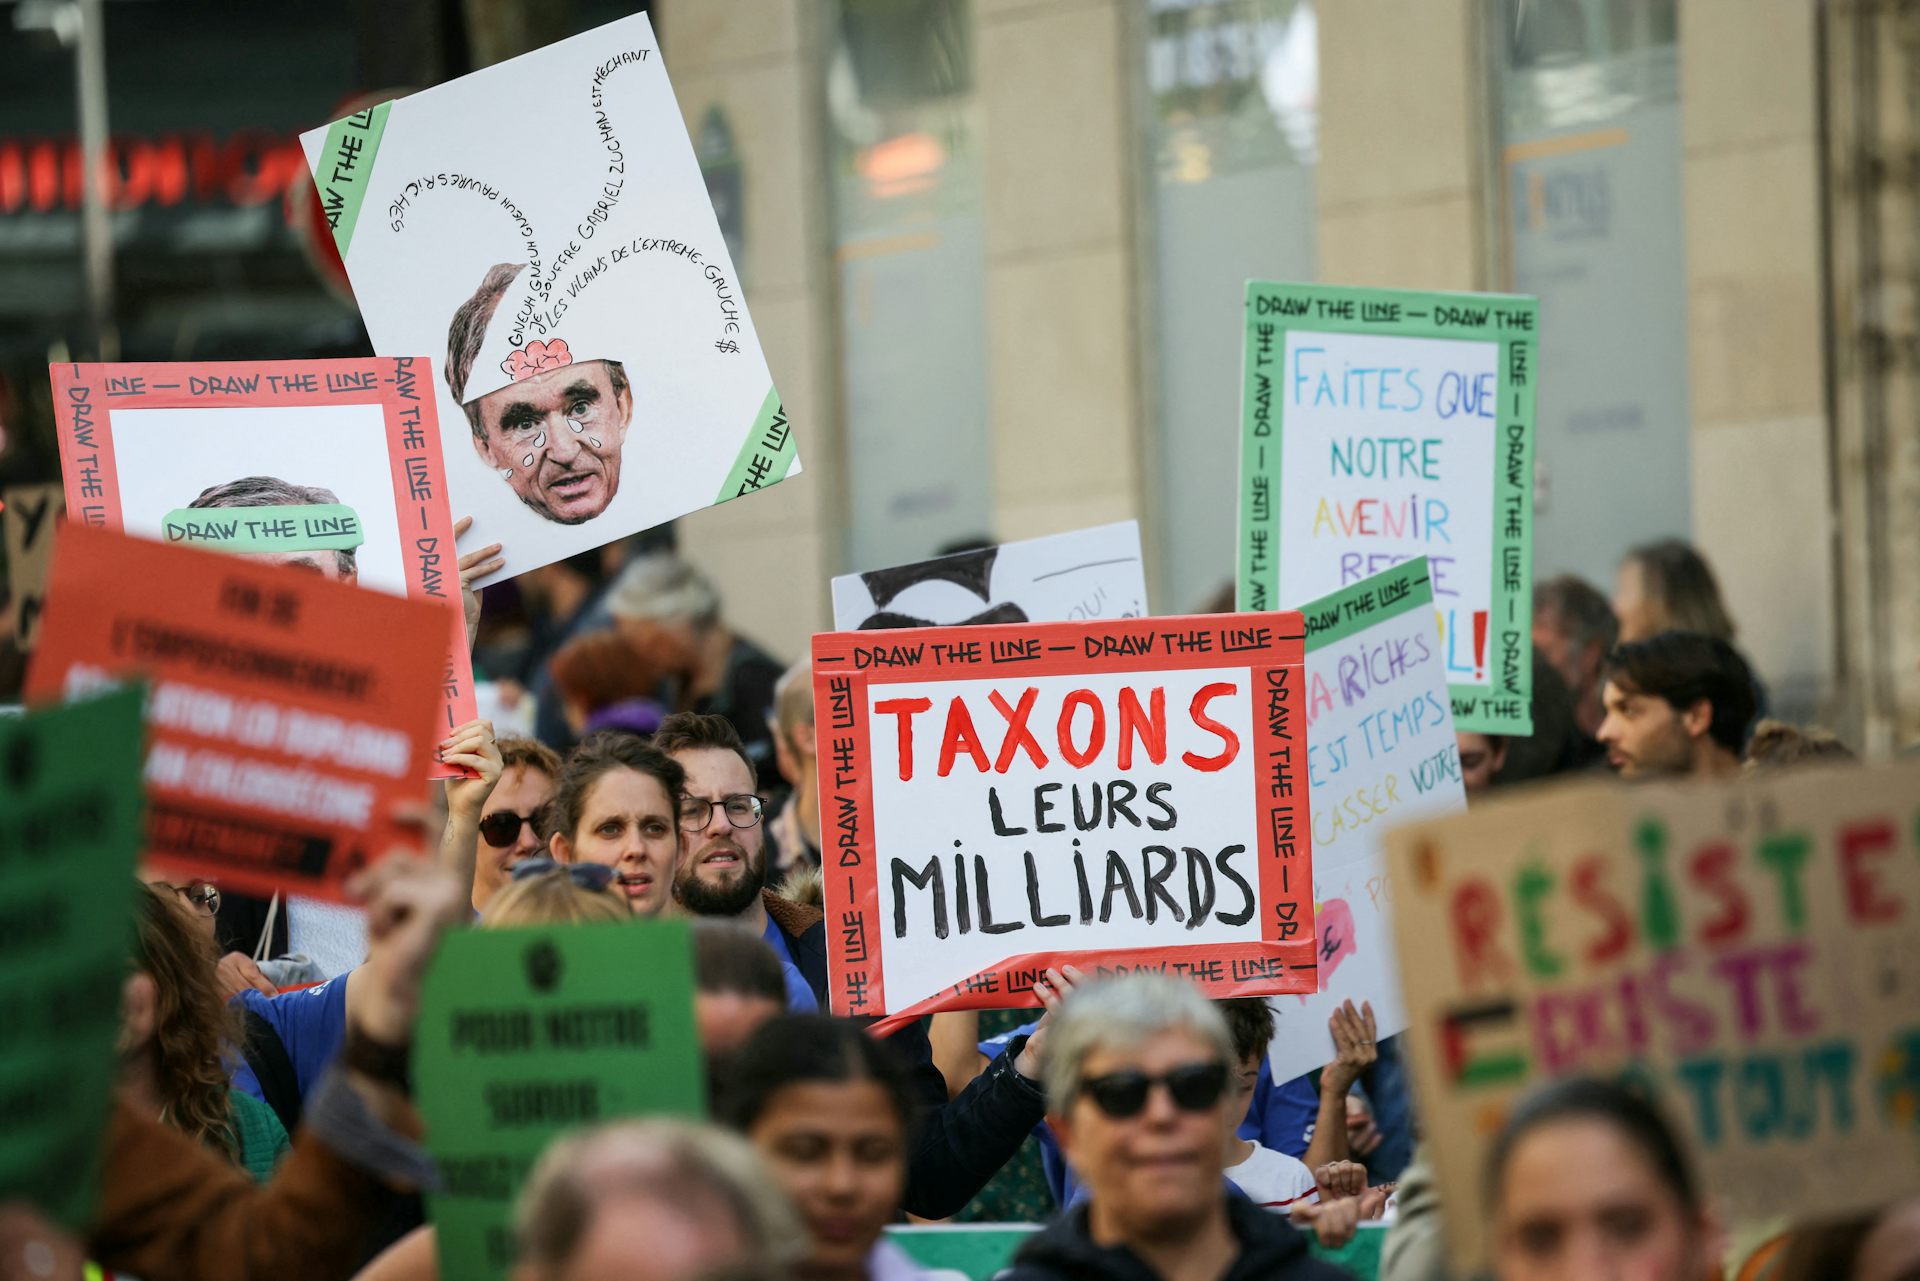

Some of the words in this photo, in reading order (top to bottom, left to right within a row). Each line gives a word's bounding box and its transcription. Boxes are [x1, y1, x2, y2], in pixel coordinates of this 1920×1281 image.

[332, 135, 363, 183] THE
[437, 173, 500, 200] PAUVRES
[529, 313, 546, 334] JE
[539, 241, 581, 302] SOUFFRE
[592, 86, 602, 107] EST
[545, 298, 568, 328] LES
[611, 246, 629, 263] DE
[1257, 295, 1312, 317] DRAW
[1316, 299, 1354, 320] THE
[1362, 303, 1401, 322] LINE
[1434, 306, 1490, 327] DRAW
[1495, 310, 1533, 331] THE
[1258, 323, 1274, 367] THE
[1509, 340, 1528, 387] LINE
[188, 373, 260, 396] DRAW
[266, 374, 318, 394] THE
[326, 371, 378, 392] LINE
[393, 357, 421, 401] RAW
[1436, 371, 1495, 420] QUE
[68, 387, 99, 449] DRAW
[399, 406, 426, 450] THE
[762, 403, 790, 452] LIN
[1254, 373, 1271, 437] DRAW
[77, 454, 103, 498] THE
[405, 457, 432, 501] LINE
[1331, 437, 1443, 480] NOTRE
[1507, 425, 1524, 489] DRAW
[1252, 476, 1269, 521] LINE
[1505, 496, 1522, 538] THE
[167, 520, 238, 542] DRAW
[244, 518, 297, 539] THE
[304, 517, 357, 538] LINE
[1251, 530, 1267, 574] THE
[416, 537, 447, 598] DRAW
[1341, 552, 1460, 596] REE
[1503, 548, 1521, 591] LINE
[1343, 592, 1375, 621] THE
[1378, 577, 1411, 608] LINE
[854, 642, 925, 669] DRAW
[931, 641, 982, 666] THE
[991, 638, 1042, 664] LINE
[1084, 632, 1154, 658] DRAW
[1161, 631, 1212, 655] THE
[1221, 627, 1272, 652] LINE
[1502, 631, 1520, 694] DRAW
[830, 677, 855, 729] LINE
[1266, 668, 1293, 740] DRAW
[1358, 690, 1446, 760] TEMPS
[1483, 700, 1522, 719] THE
[874, 682, 1241, 782] TAXONS
[833, 737, 857, 790] THE
[1269, 746, 1293, 798] THE
[989, 779, 1178, 837] LEURS
[1311, 774, 1400, 846] CASSER
[834, 796, 861, 868] DRAW
[1271, 806, 1296, 859] LINE
[842, 911, 867, 963] LINE
[1275, 902, 1298, 940] DR
[1172, 960, 1225, 982] THE
[1232, 957, 1283, 982] LINE
